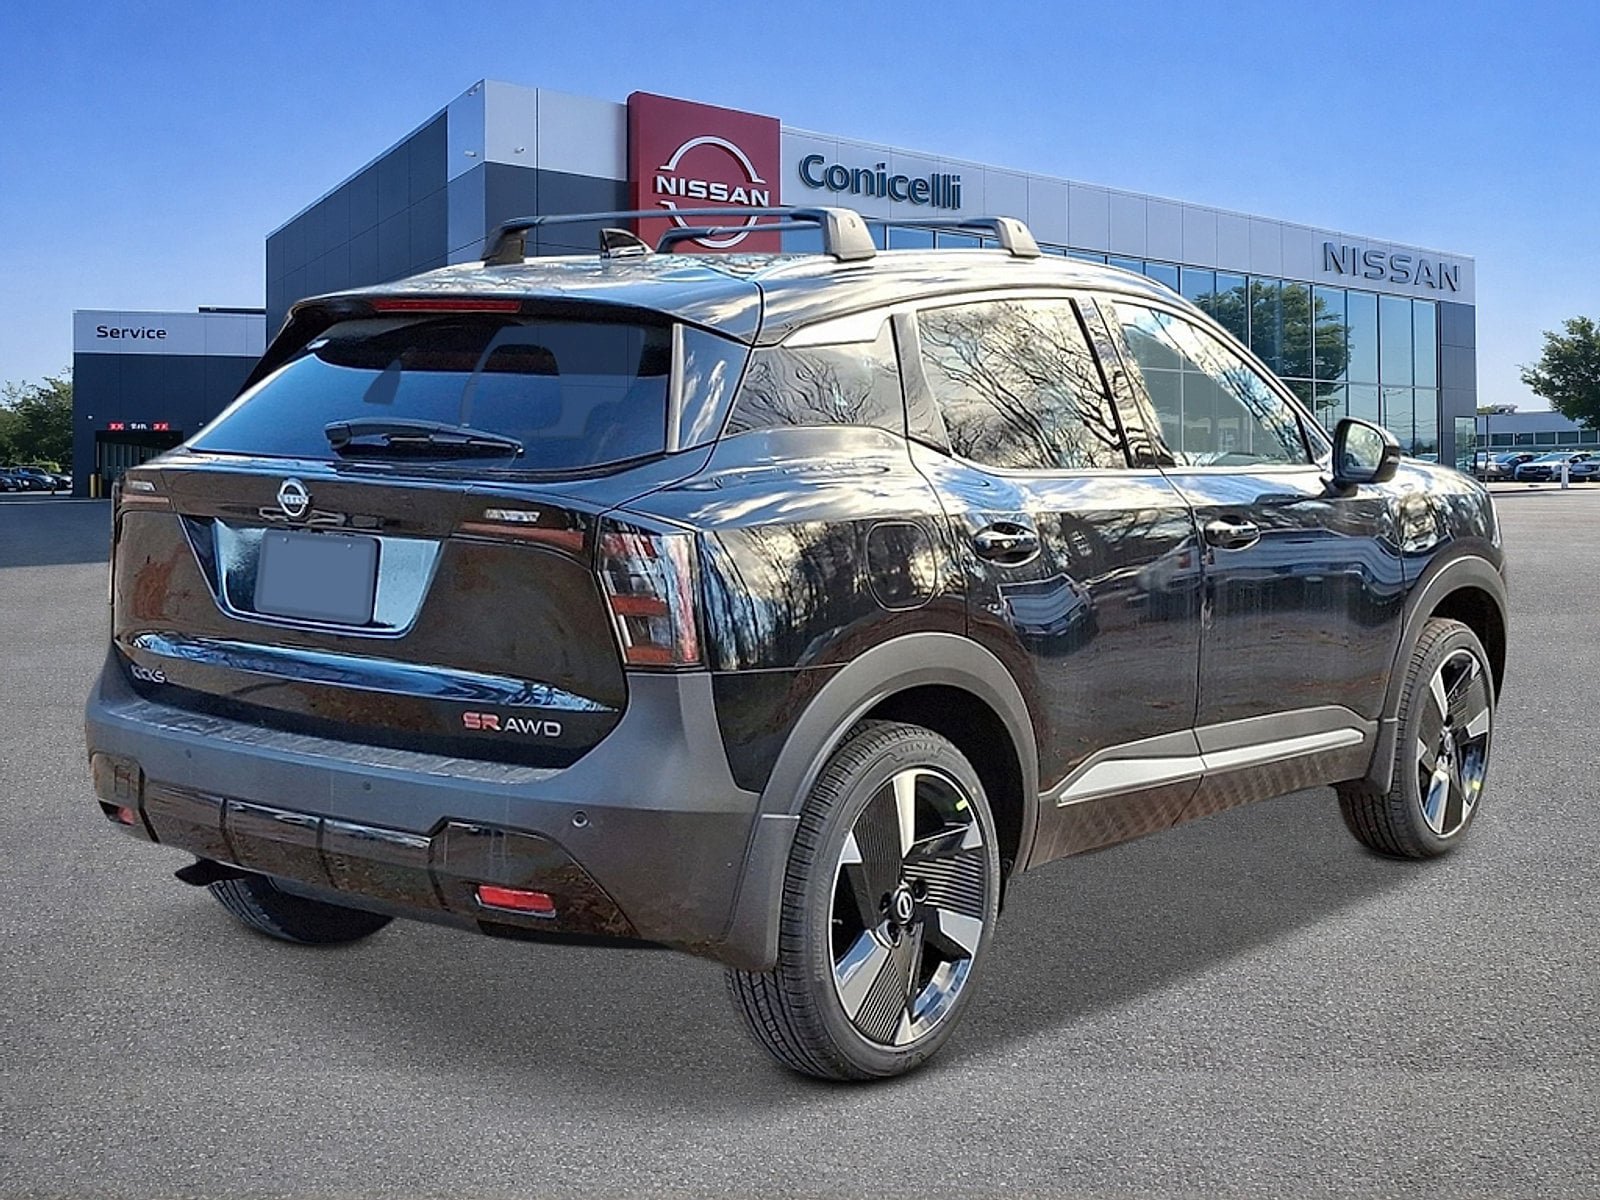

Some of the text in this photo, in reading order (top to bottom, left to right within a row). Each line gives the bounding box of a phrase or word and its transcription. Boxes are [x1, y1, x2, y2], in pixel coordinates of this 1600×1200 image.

[655, 175, 770, 207] NISSAN
[800, 154, 961, 210] Conicelli
[1323, 242, 1461, 292] NISSAN
[96, 325, 167, 339] Service
[463, 711, 561, 737] SR AWD
